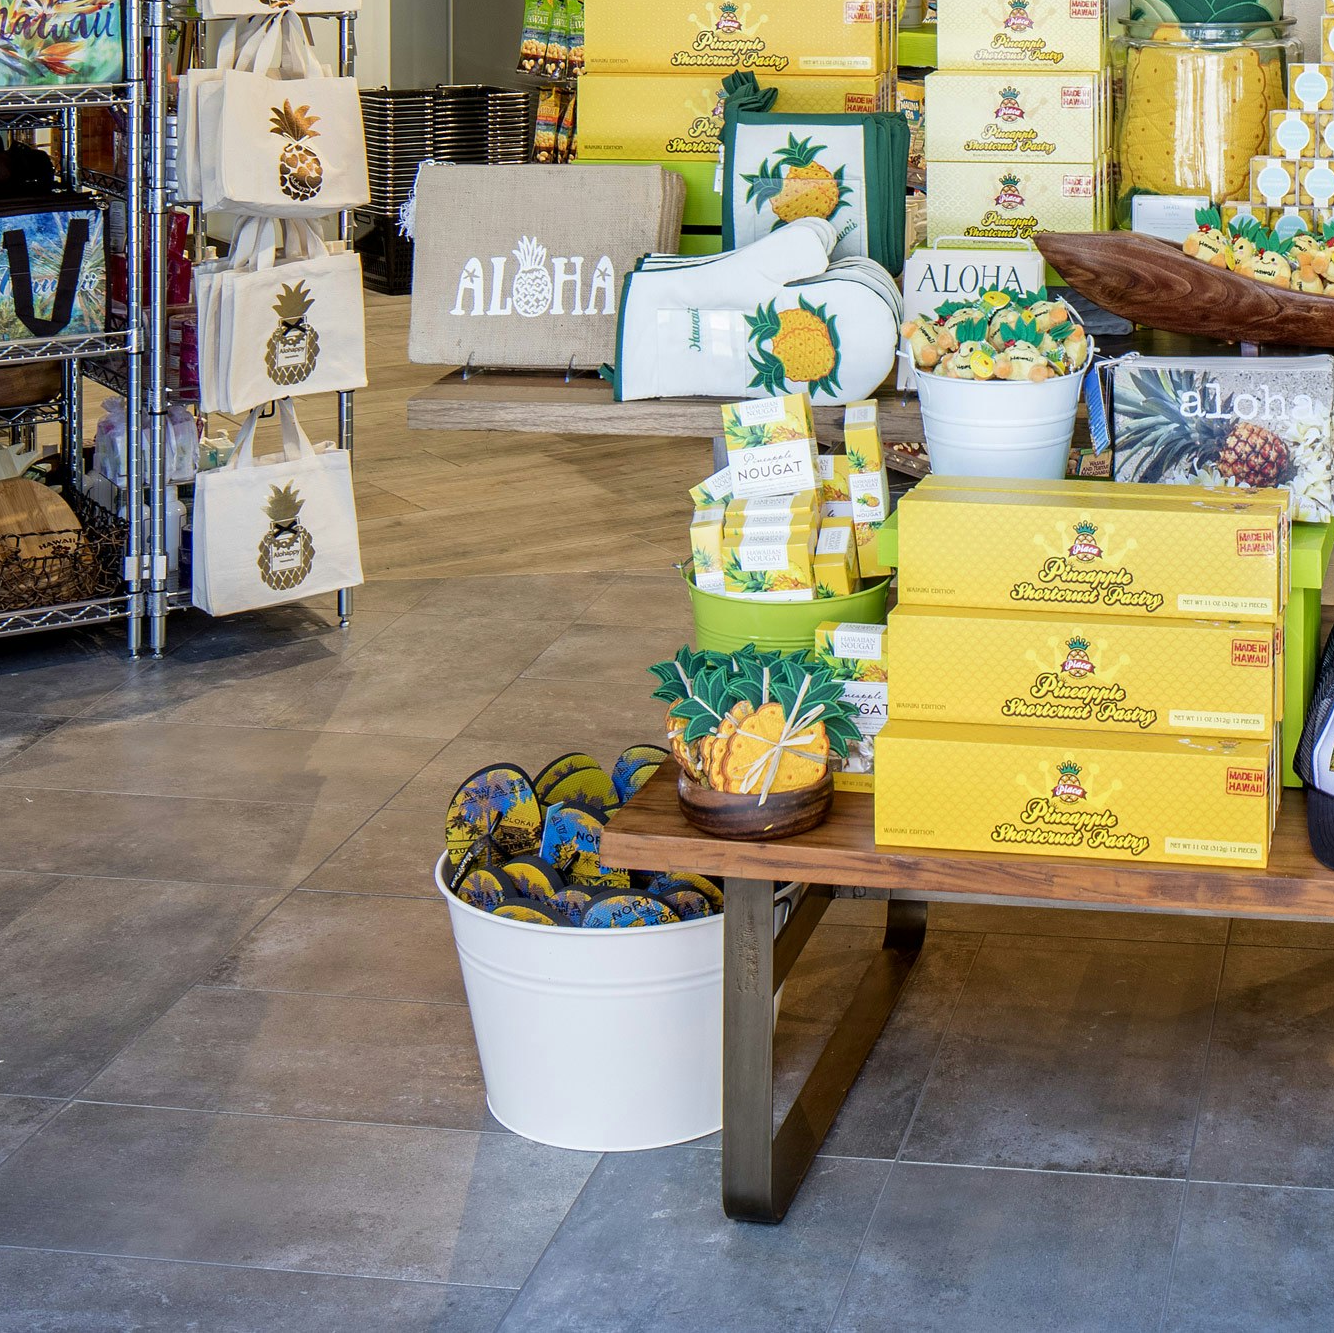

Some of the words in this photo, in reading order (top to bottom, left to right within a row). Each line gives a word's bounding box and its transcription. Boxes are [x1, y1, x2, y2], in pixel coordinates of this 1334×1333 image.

[692, 30, 765, 55] Pineapple
[991, 32, 1046, 50] Pineapple
[671, 50, 741, 68] Shortcrust
[742, 52, 789, 72] Pastry
[974, 48, 1026, 63] Shortcrust
[1028, 48, 1065, 64] Pastry
[981, 124, 1038, 141] Pineapple
[964, 139, 1018, 153] Shortcrust
[1019, 140, 1056, 155] Pastry
[981, 210, 1038, 228] Pineapple
[917, 263, 1024, 295] ALOHA
[686, 307, 700, 352] Hawaii
[279, 345, 305, 356] Alohappy
[1180, 383, 1315, 420] aloha
[743, 450, 792, 466] Pineapple
[738, 460, 803, 481] NOUGAT
[1239, 533, 1263, 543] MADE
[1264, 533, 1272, 543] IN
[273, 547, 301, 559] Alohappy
[1240, 543, 1273, 554] HAWAII
[1039, 556, 1133, 586] Pineapple
[1011, 581, 1099, 604] Shortcrust
[1104, 585, 1164, 612] Pastry
[841, 642, 875, 650] NOUGAT
[1234, 643, 1257, 653] MADE
[1259, 644, 1267, 654] IN
[1234, 654, 1268, 664] HAWAII
[1030, 672, 1126, 702] Pineapple
[1002, 697, 1092, 721] Shortcrust
[1096, 701, 1157, 728] Pastry
[1229, 771, 1252, 781] MADE
[1254, 772, 1263, 782] IN
[1229, 782, 1263, 793] HAWAII
[1020, 796, 1117, 828] Pineapple
[502, 815, 535, 827] OLOKAI
[576, 830, 600, 842] NOR
[991, 824, 1082, 848] Shortcrust
[1087, 827, 1149, 854] Pastry
